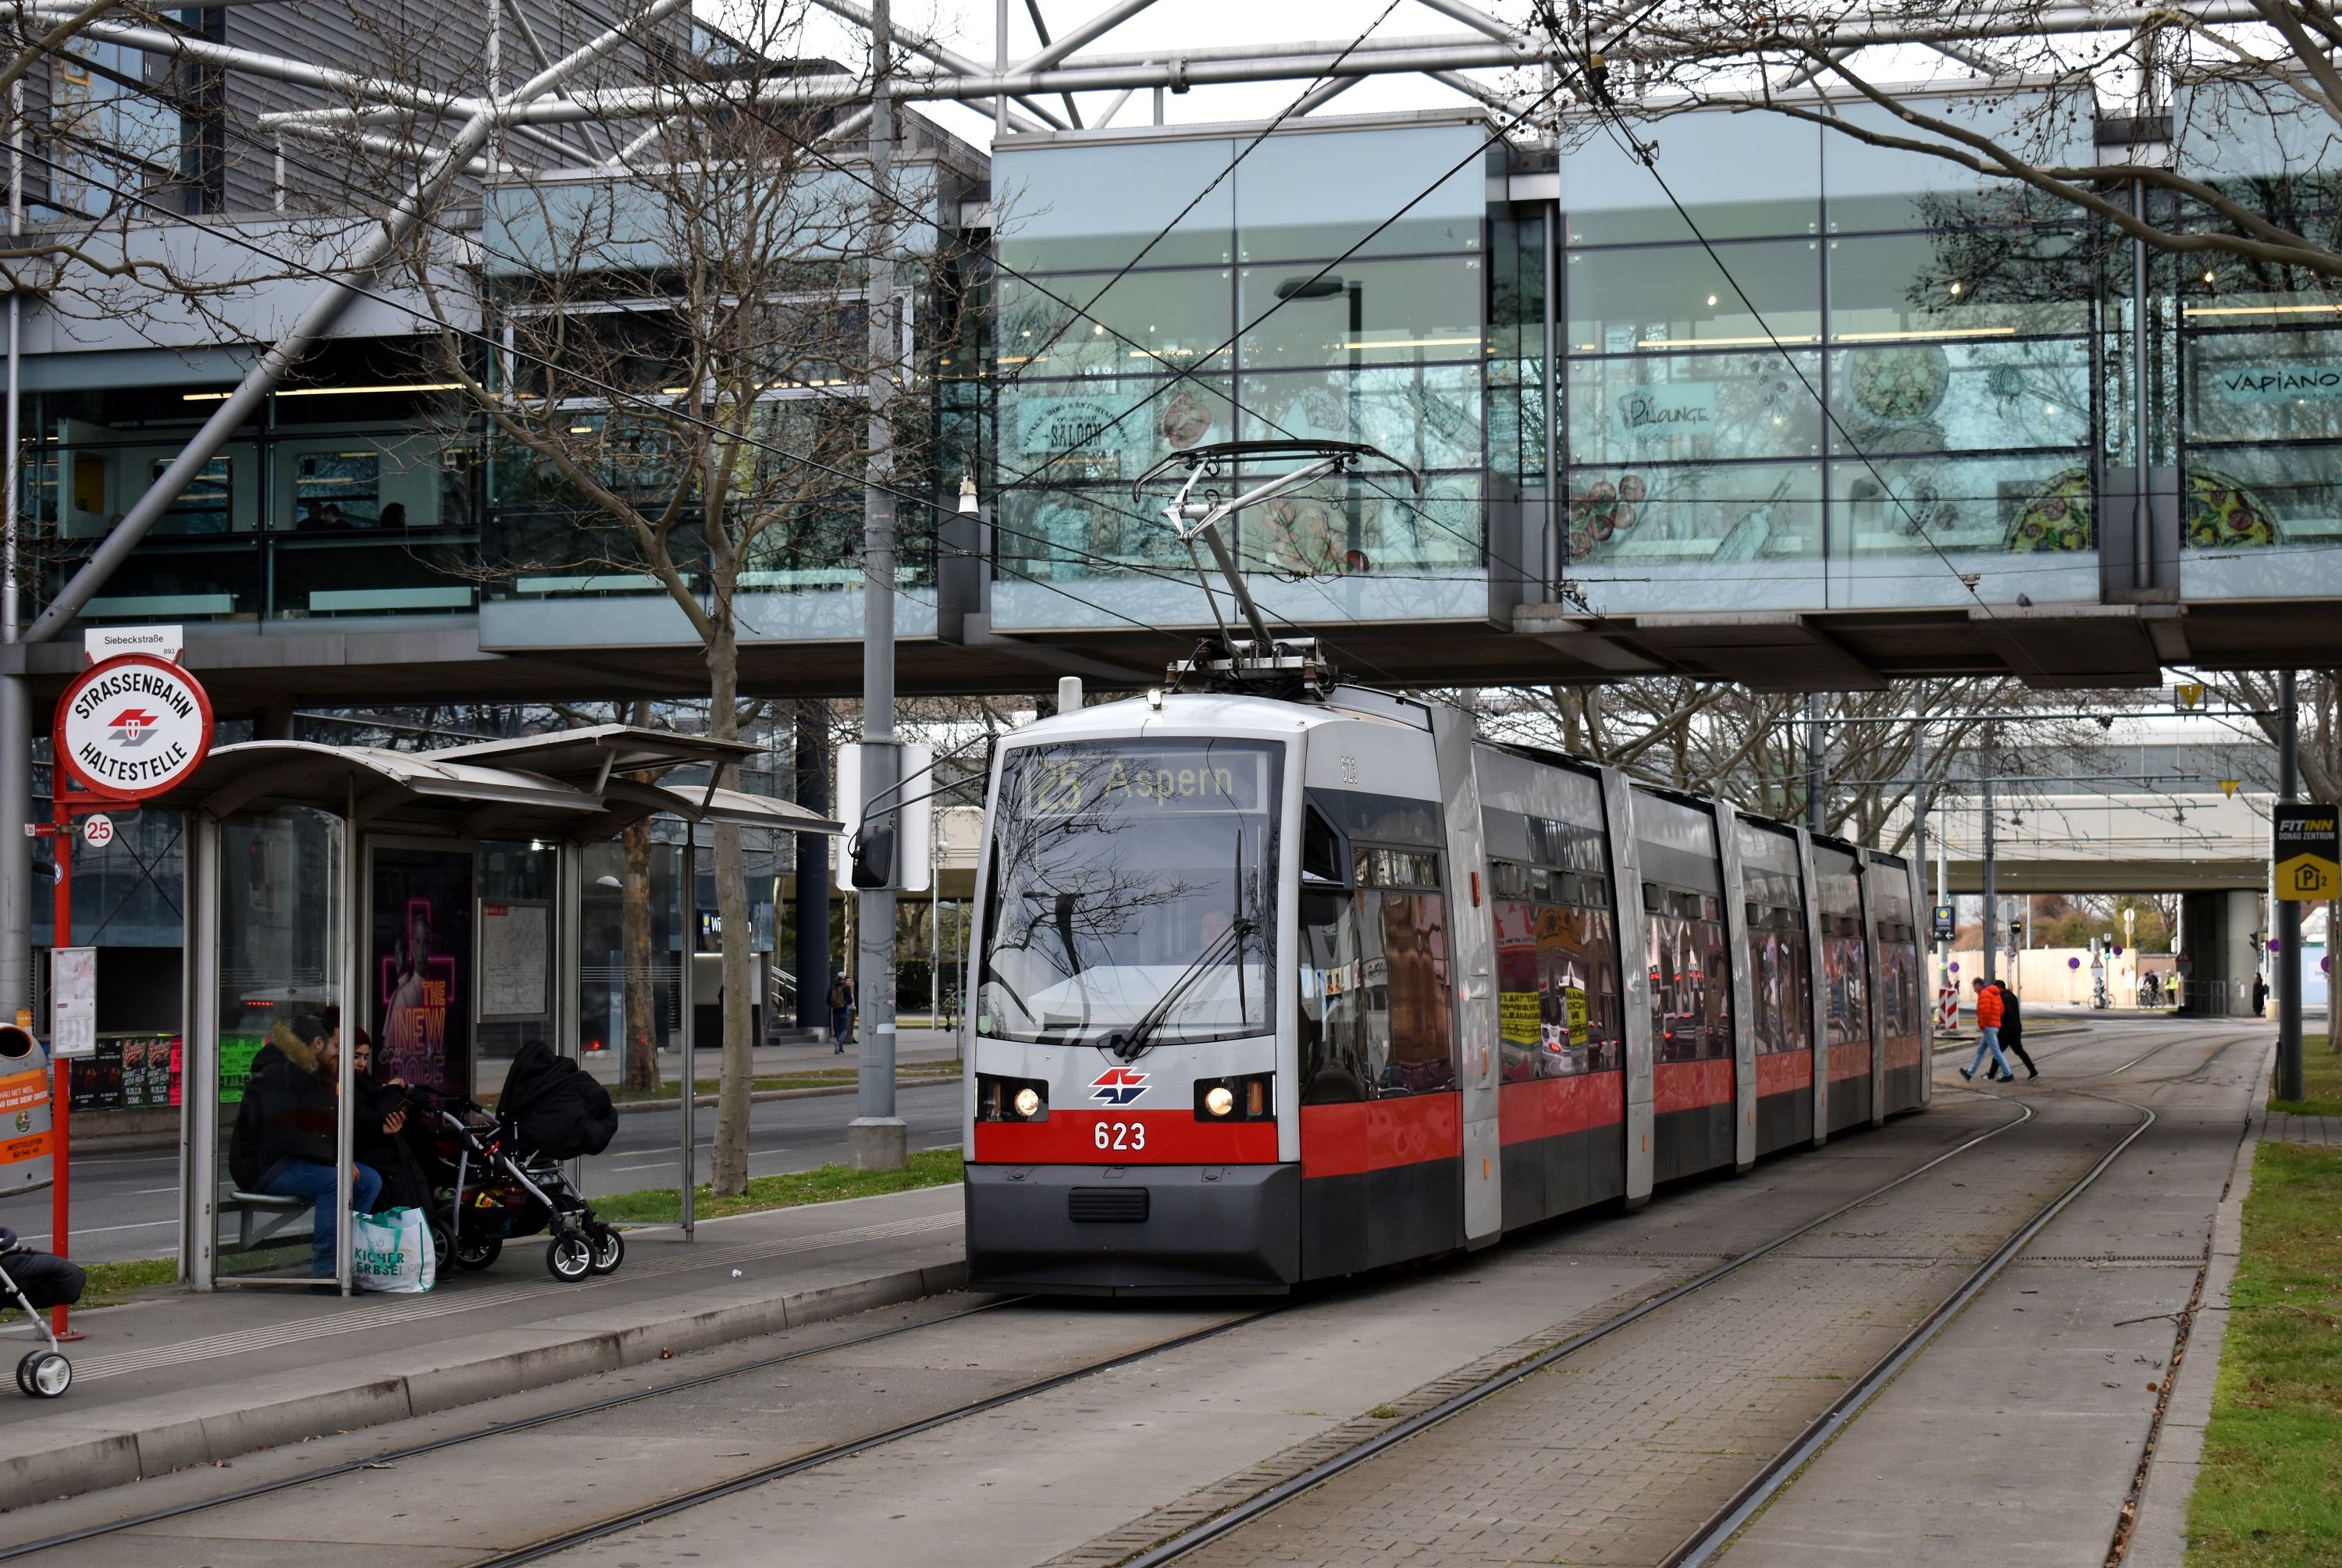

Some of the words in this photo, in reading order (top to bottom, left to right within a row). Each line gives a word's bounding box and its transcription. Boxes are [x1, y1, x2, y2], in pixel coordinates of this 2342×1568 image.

[1051, 423, 1102, 448] SALOON
[104, 634, 164, 645] Siebeckstraße
[75, 673, 194, 720] STRASSENBAHN
[79, 741, 187, 781] HALTESTELLE
[1340, 756, 1358, 784] 623
[1037, 759, 1081, 810] 25
[1103, 759, 1233, 807] Aspern
[87, 822, 111, 840] 25
[2278, 832, 2302, 841] DONAU
[2303, 831, 2335, 841] ZENTRUM
[2279, 820, 2334, 831] FITINN
[2303, 869, 2314, 887] P
[2321, 876, 2327, 887] 2
[422, 980, 446, 1005] THE
[393, 1007, 446, 1055] NEW
[1094, 1122, 1145, 1150] 623
